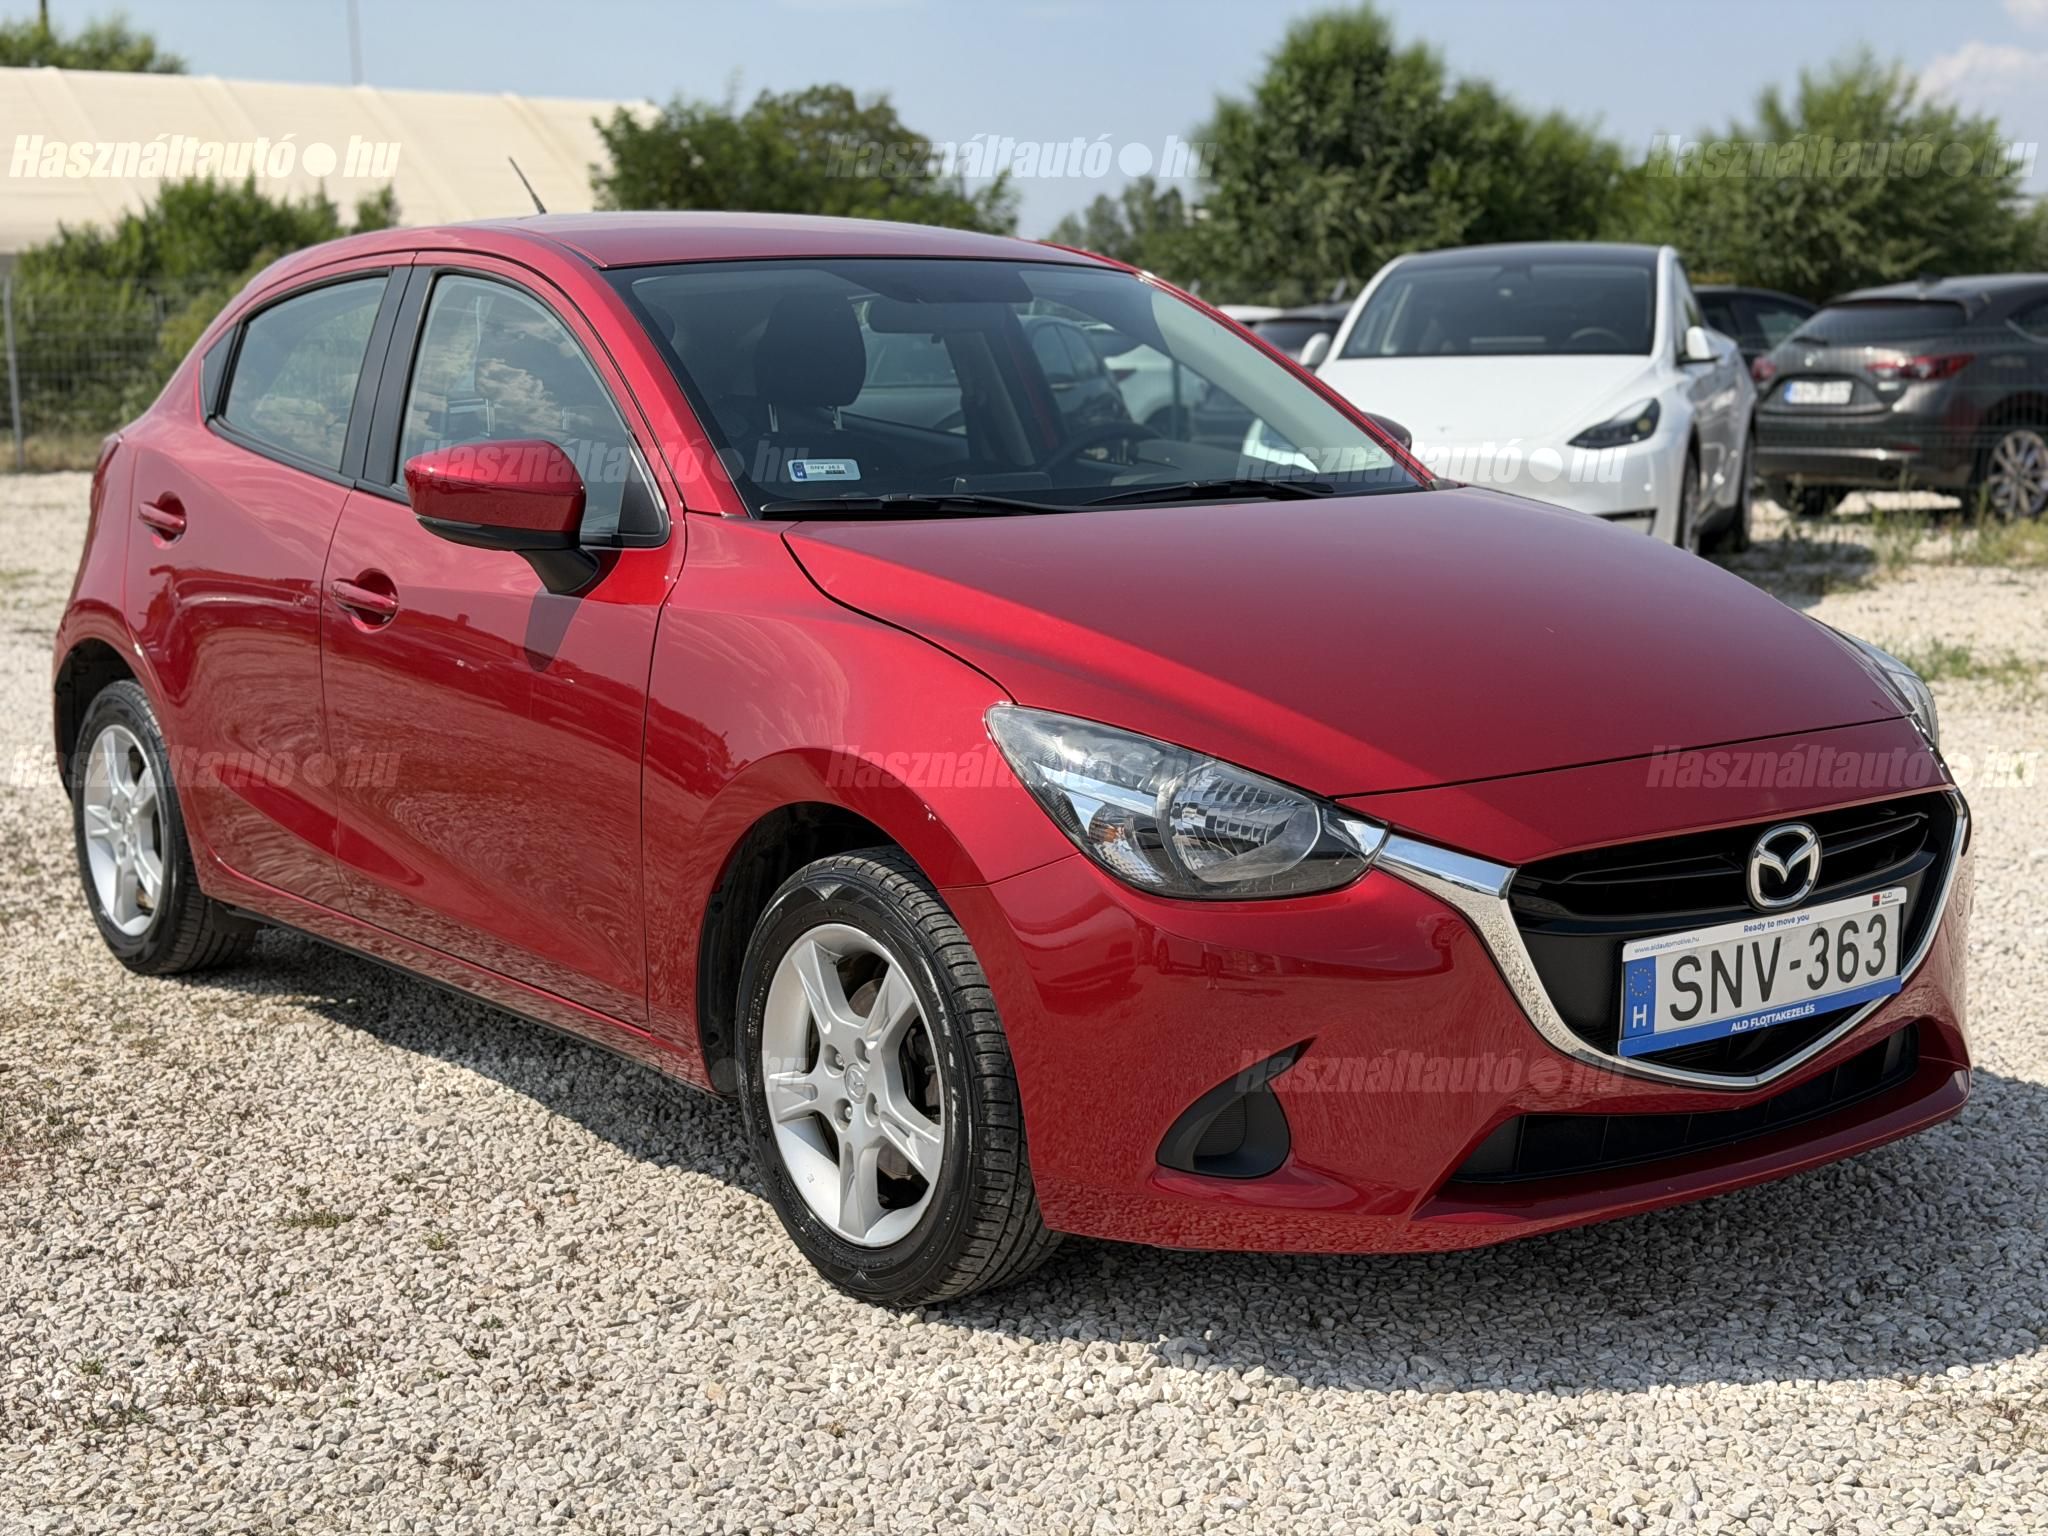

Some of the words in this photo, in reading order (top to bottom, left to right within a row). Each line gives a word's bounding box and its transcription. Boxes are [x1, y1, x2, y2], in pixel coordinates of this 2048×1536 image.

[1743, 923, 1766, 934] Ready
[1776, 916, 1796, 927] move
[1796, 914, 1810, 924] you
[1669, 913, 1887, 1022] SNV-363
[1632, 1004, 1647, 1029] H
[1730, 1019, 1749, 1033] ALD
[1750, 1003, 1816, 1027] FLOTTAKEZELÉS
